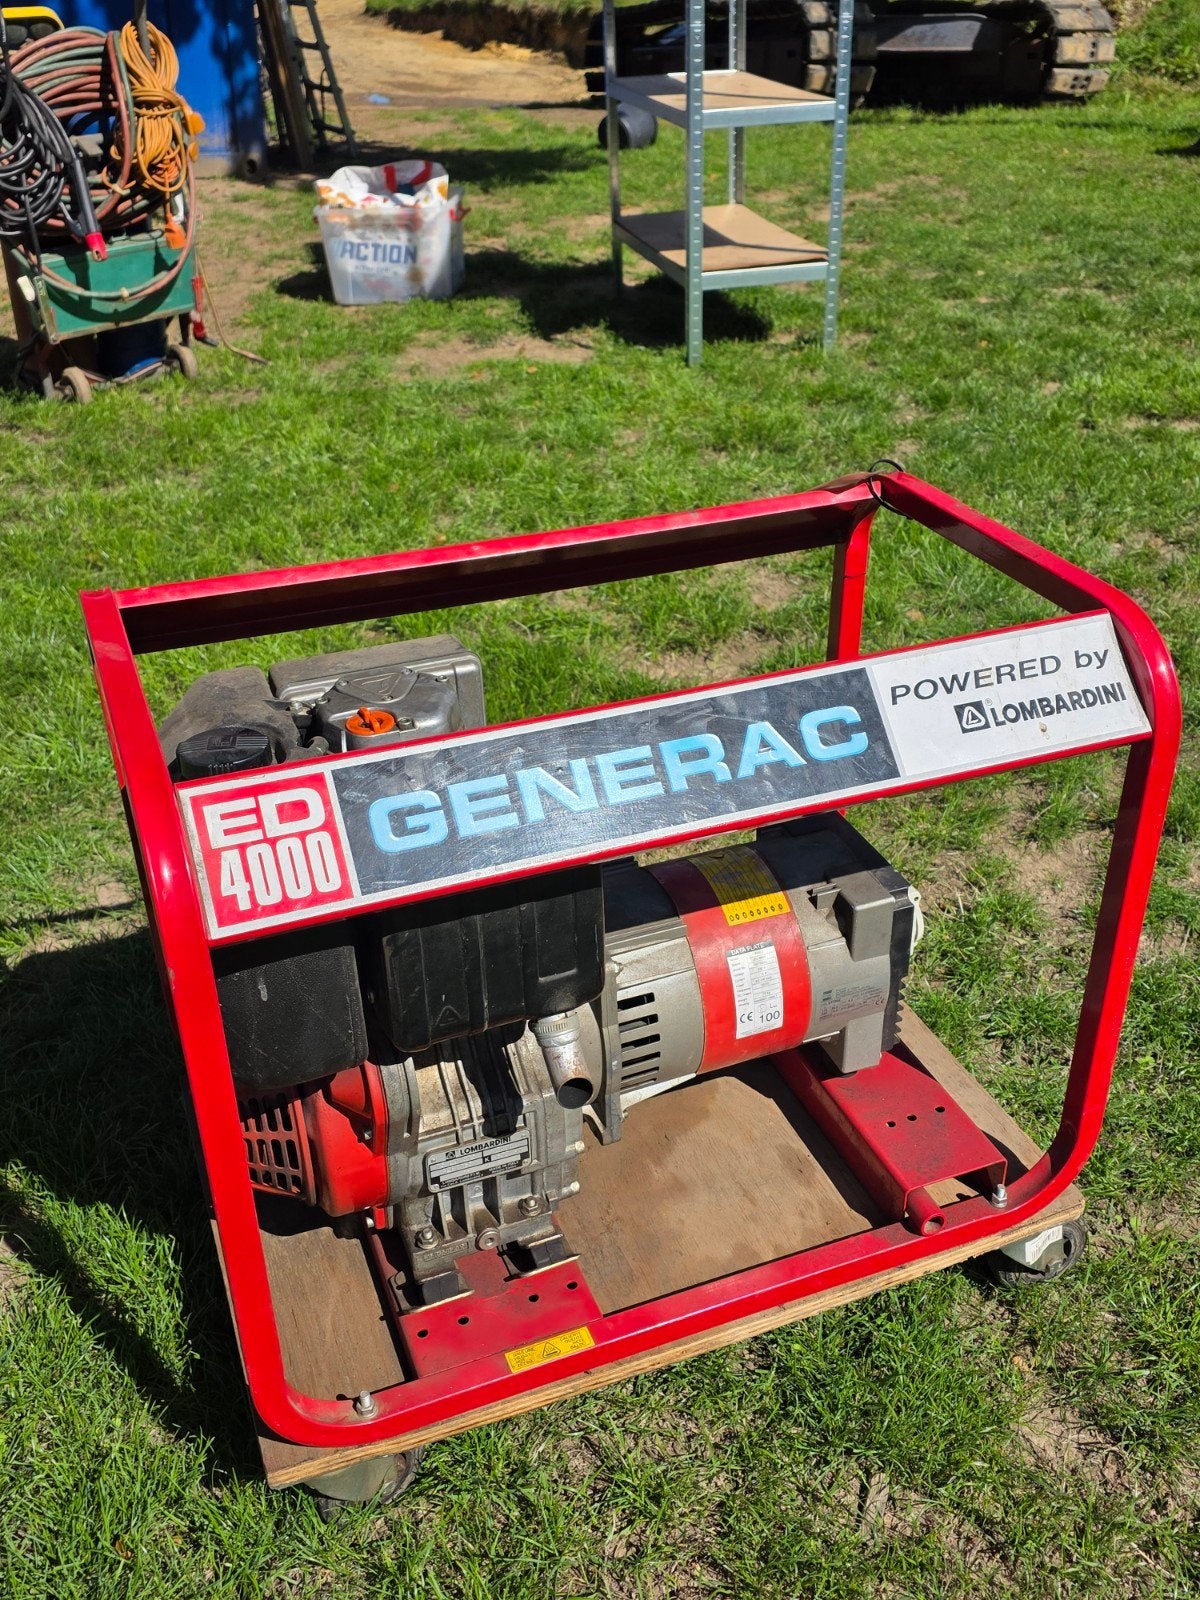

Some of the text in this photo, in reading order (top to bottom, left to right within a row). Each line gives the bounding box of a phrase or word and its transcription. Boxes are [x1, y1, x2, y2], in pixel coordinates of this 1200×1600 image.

[340, 240, 418, 264] ACTION
[890, 648, 1109, 705] POWERED by
[990, 681, 1127, 727] LOMBARDINI
[368, 705, 870, 854] GENERAC
[203, 786, 326, 850] ED
[220, 830, 343, 912] 4000
[730, 946, 746, 956] DATA
[759, 1010, 780, 1024] 100
[460, 1136, 511, 1156] LOMBARDINI
